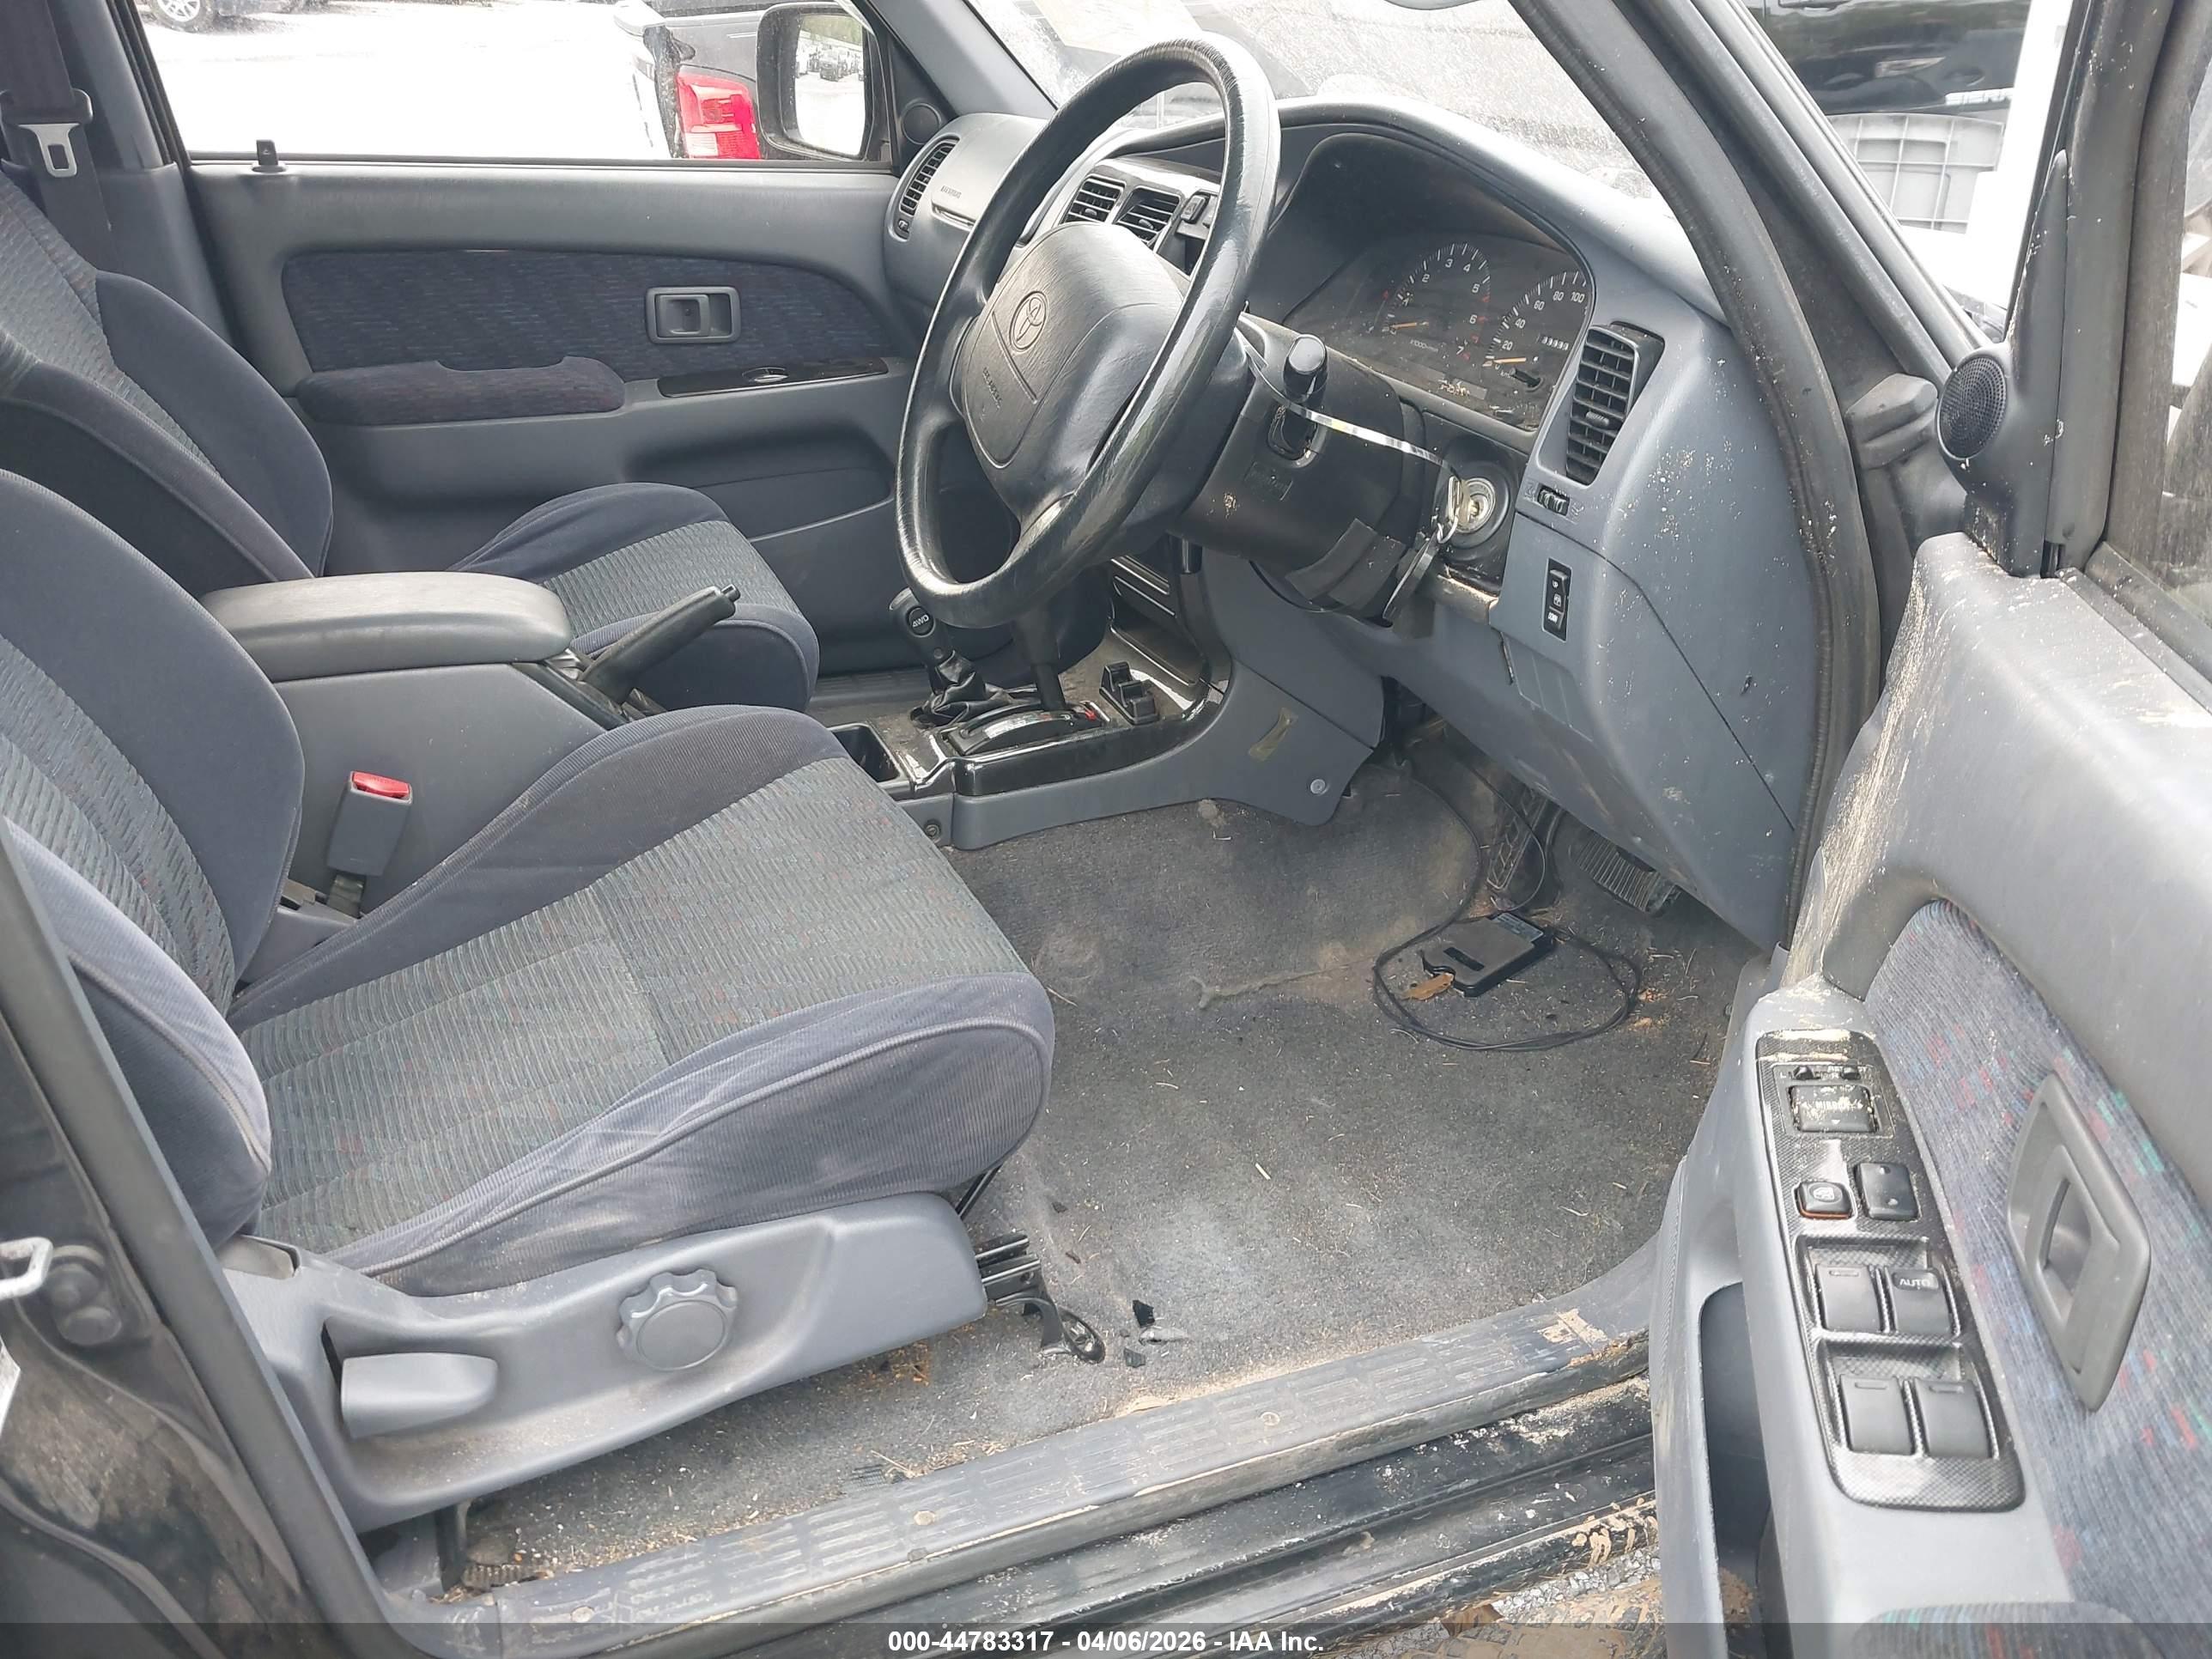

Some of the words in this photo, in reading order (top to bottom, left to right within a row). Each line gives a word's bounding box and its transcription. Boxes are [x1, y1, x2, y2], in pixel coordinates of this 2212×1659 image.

[1444, 258, 1453, 268] 3
[1463, 263, 1471, 272] 4
[1421, 273, 1430, 283] 2
[1471, 283, 1480, 293] 5
[1553, 290, 1564, 301] 80
[1571, 291, 1585, 303] 100
[1534, 300, 1545, 311] 60
[1469, 313, 1478, 324] 6
[1515, 318, 1526, 328] 40
[1456, 345, 1464, 355] 7
[1502, 340, 1513, 350] 20
[1899, 1278, 1931, 1287] AUTO
